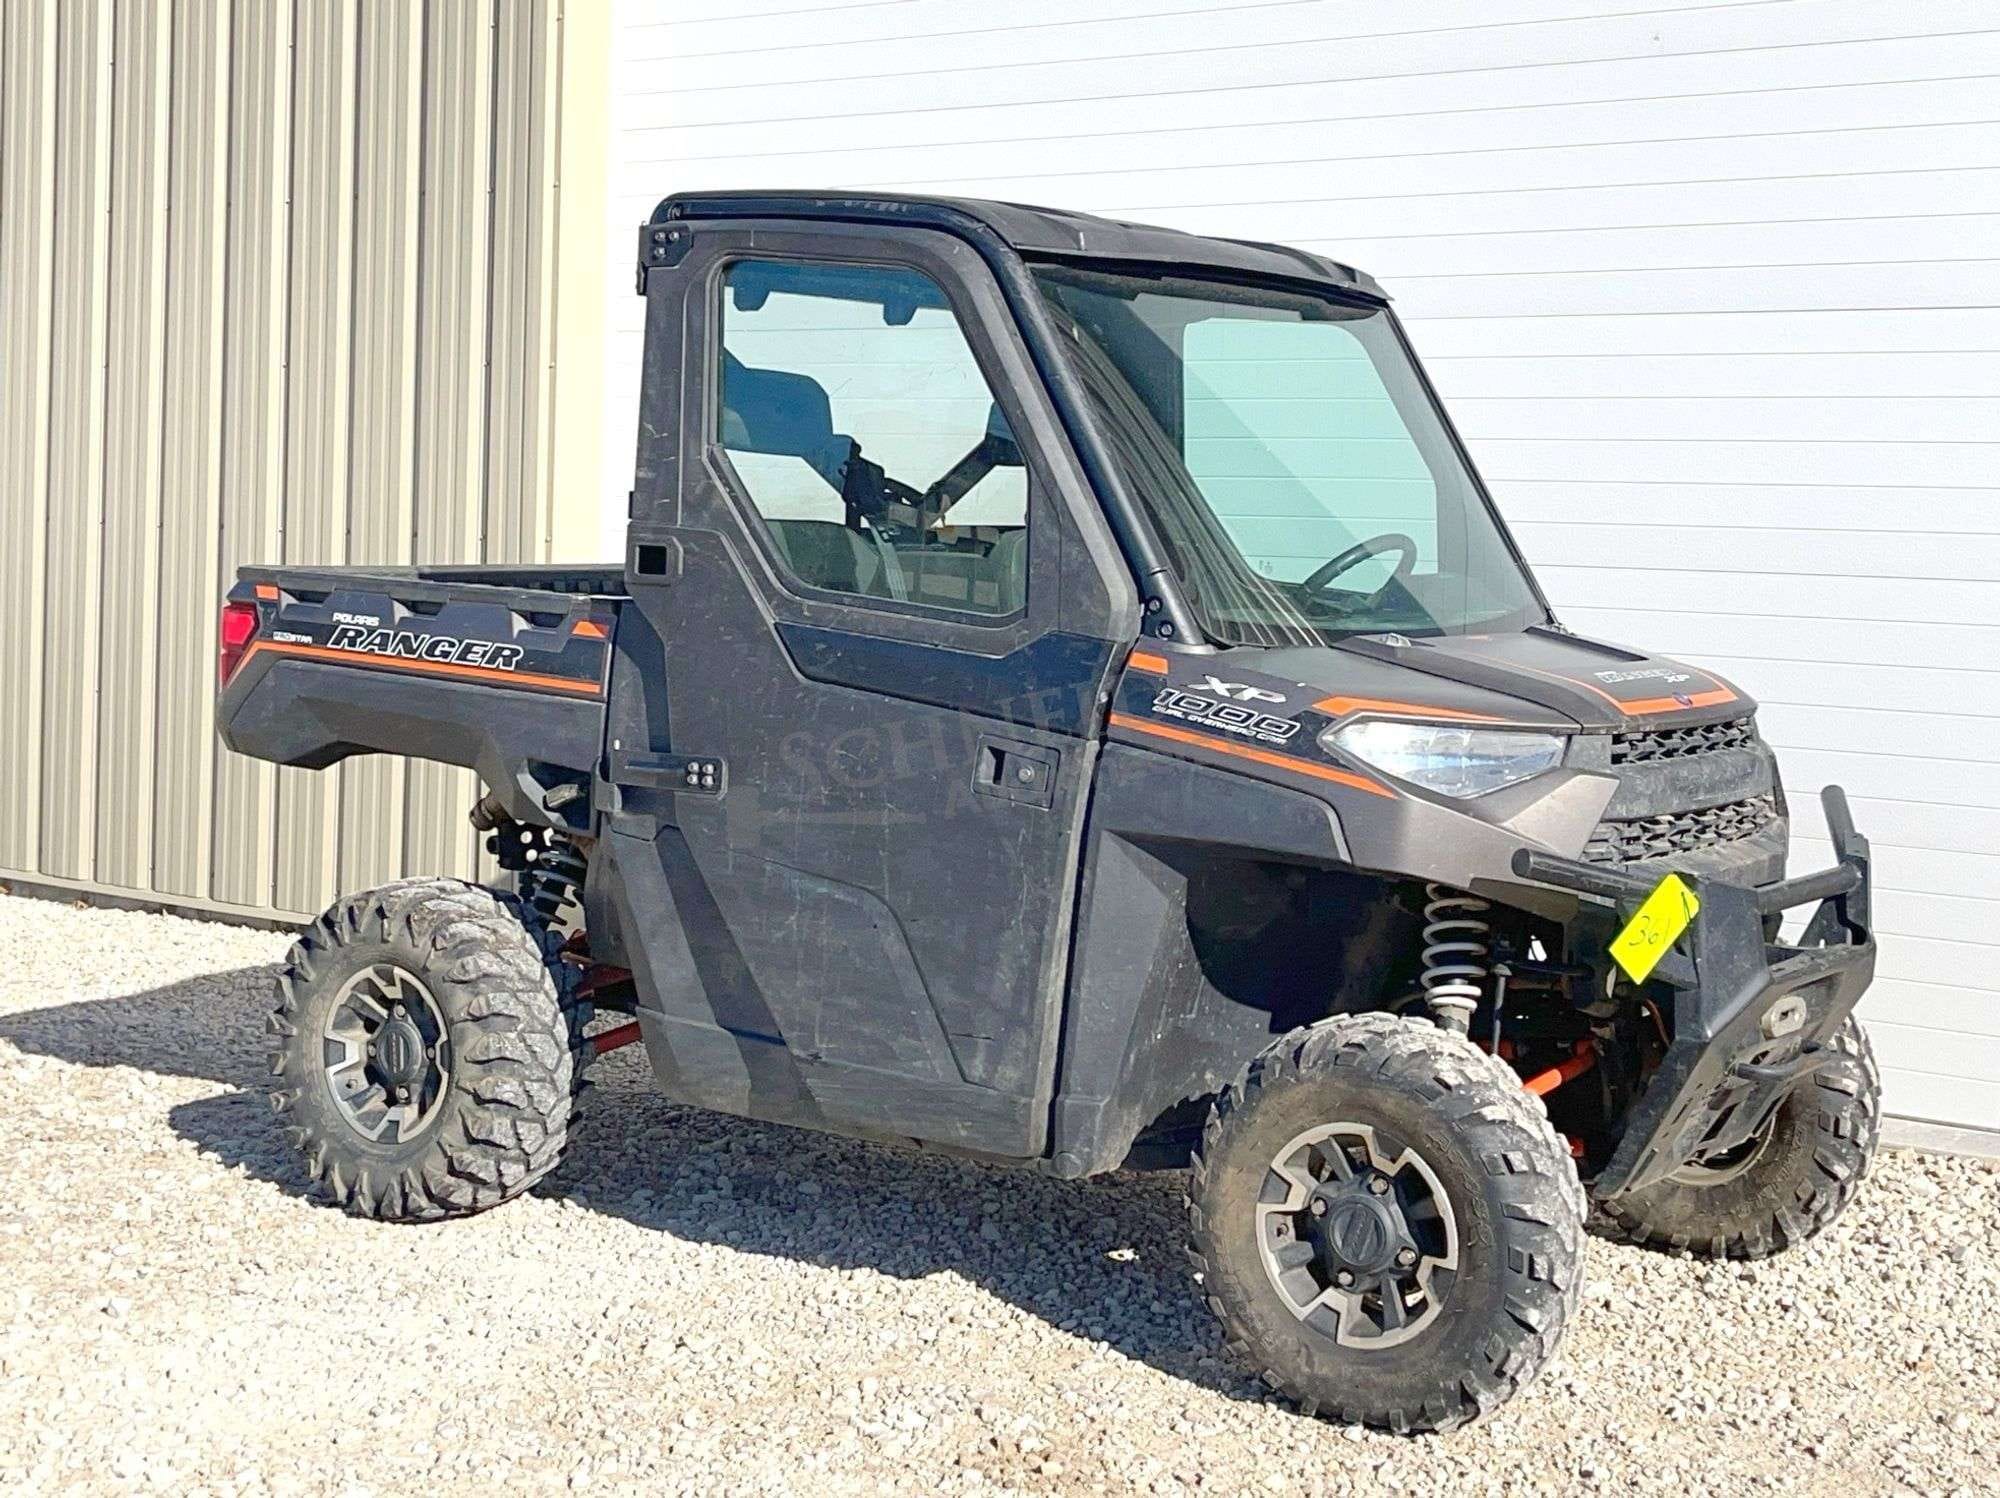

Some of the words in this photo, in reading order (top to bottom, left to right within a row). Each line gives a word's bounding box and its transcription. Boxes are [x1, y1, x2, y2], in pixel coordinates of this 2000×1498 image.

[332, 612, 380, 627] POLARIS
[327, 624, 523, 670] RANGER
[1187, 675, 1287, 703] XP
[1151, 705, 1186, 720] DUAL
[1256, 732, 1288, 746] CAM
[1153, 687, 1301, 739] 1000
